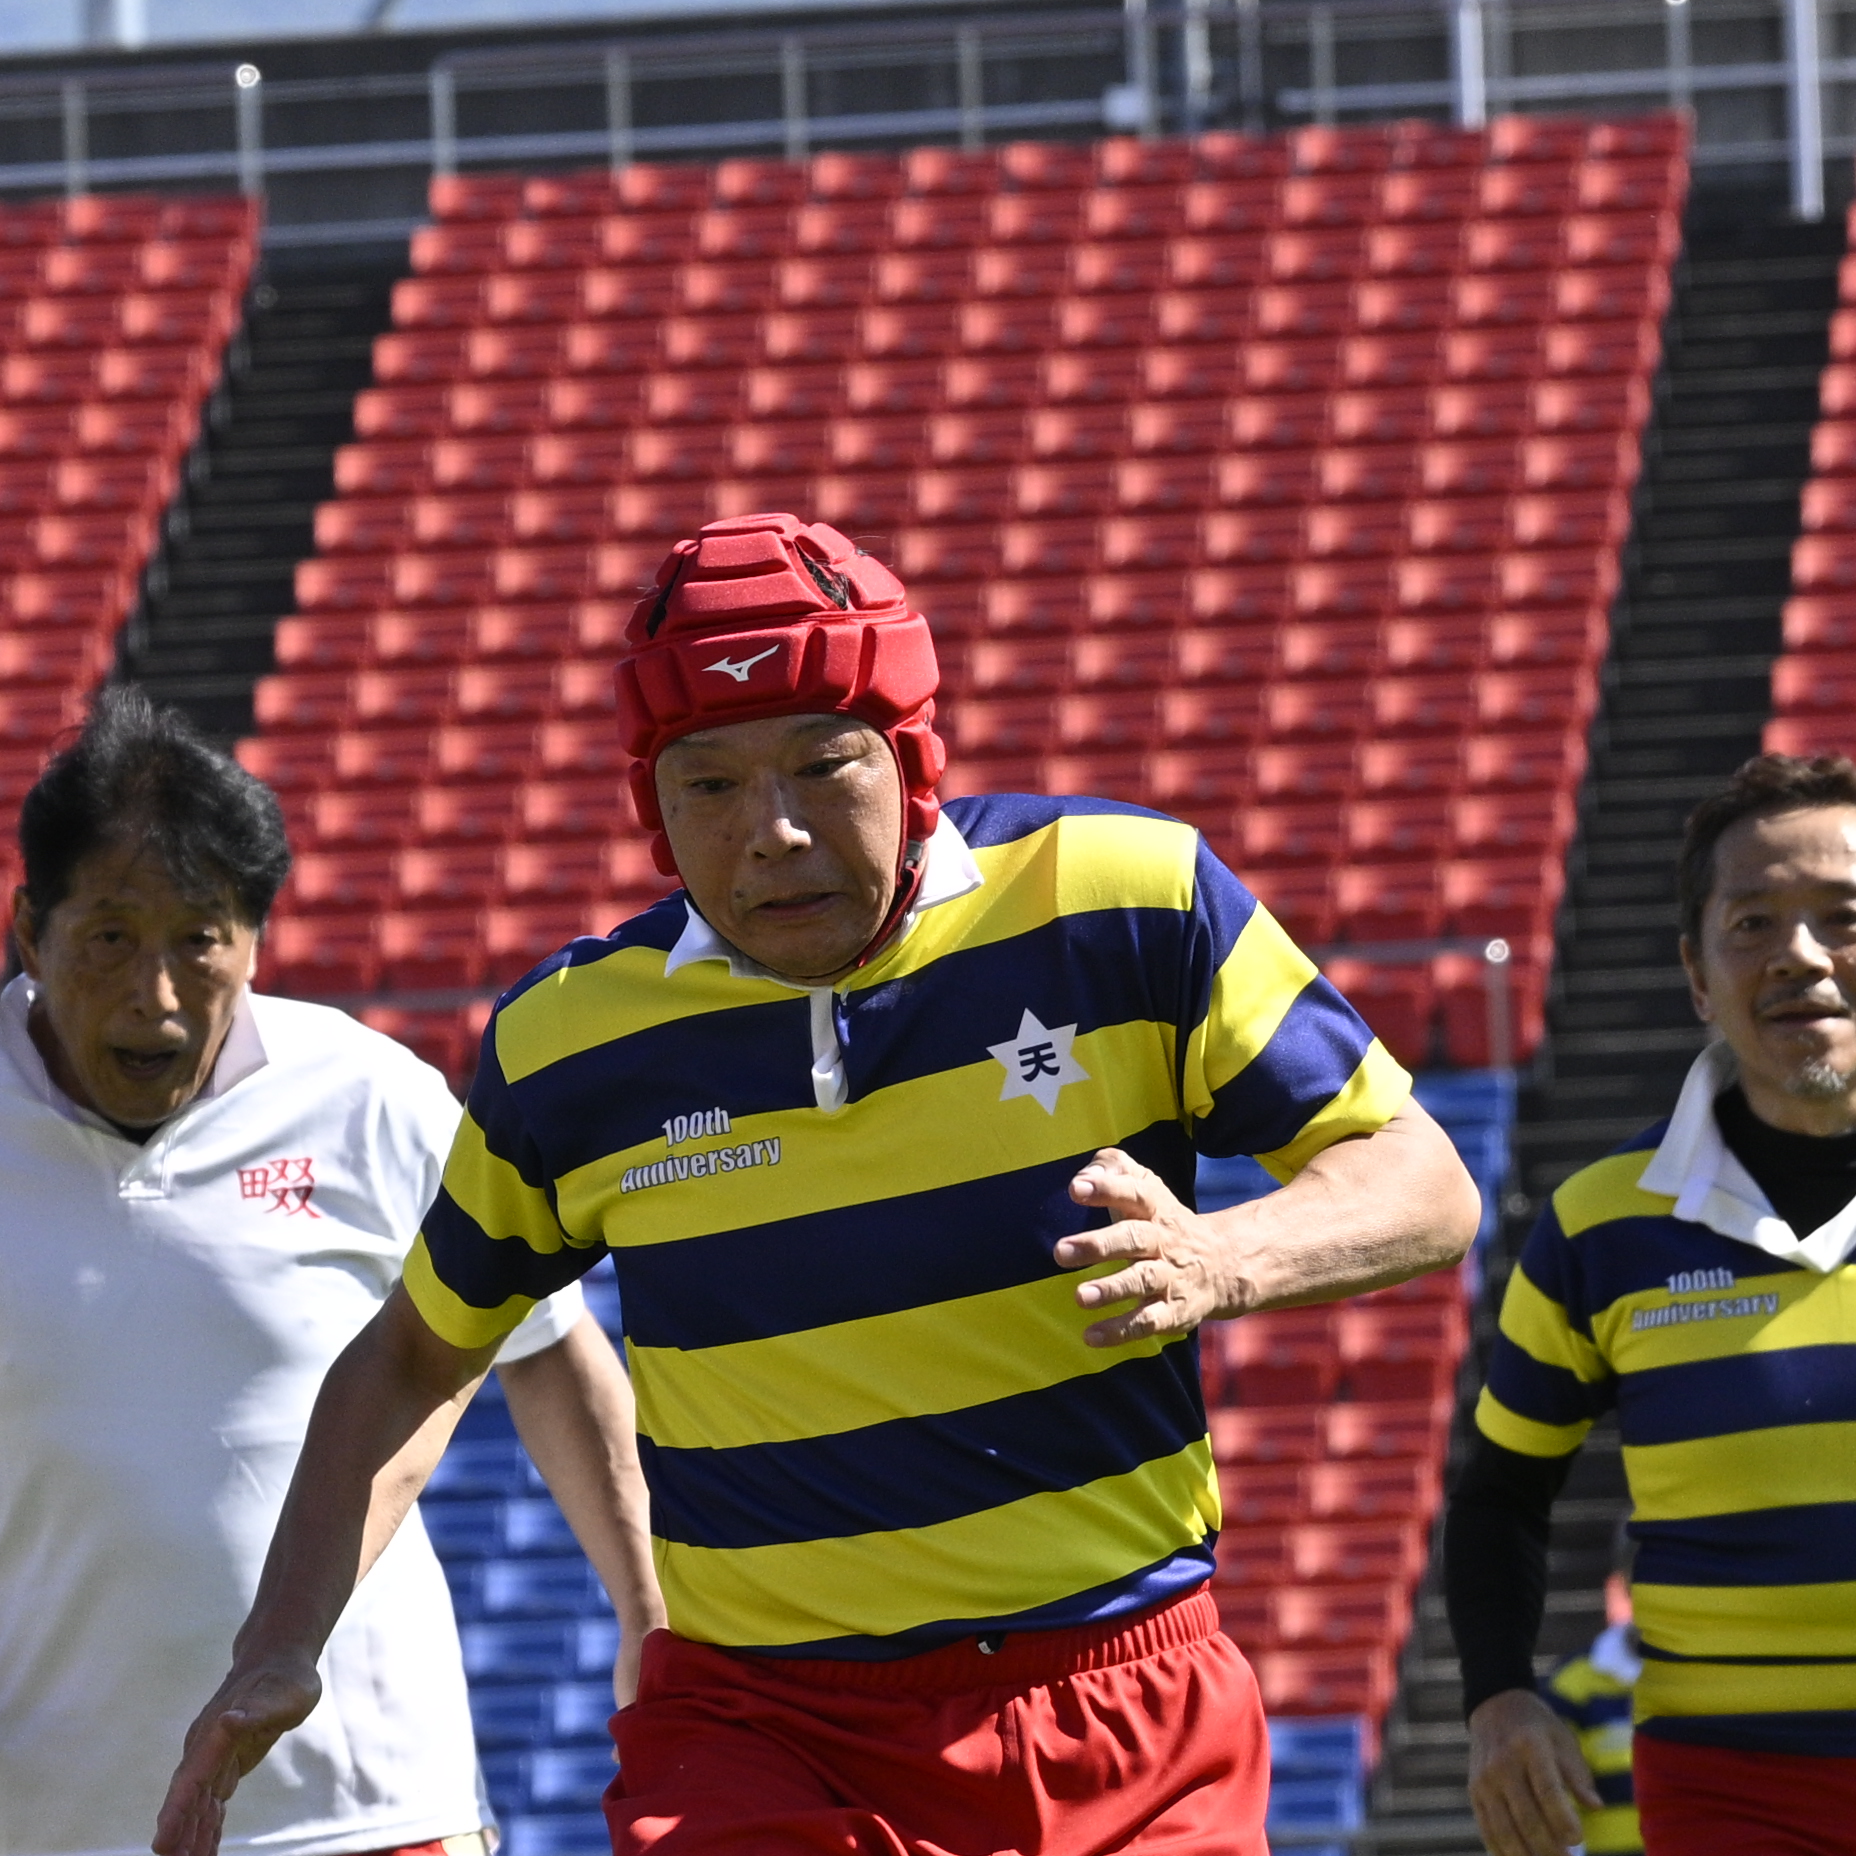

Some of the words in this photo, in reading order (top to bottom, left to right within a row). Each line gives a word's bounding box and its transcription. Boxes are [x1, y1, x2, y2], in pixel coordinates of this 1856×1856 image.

[662, 1106, 731, 1147] 100th
[620, 1137, 781, 1194] Anniversary
[1666, 1266, 1735, 1296] 100th
[1632, 1292, 1779, 1332] Anniversary
